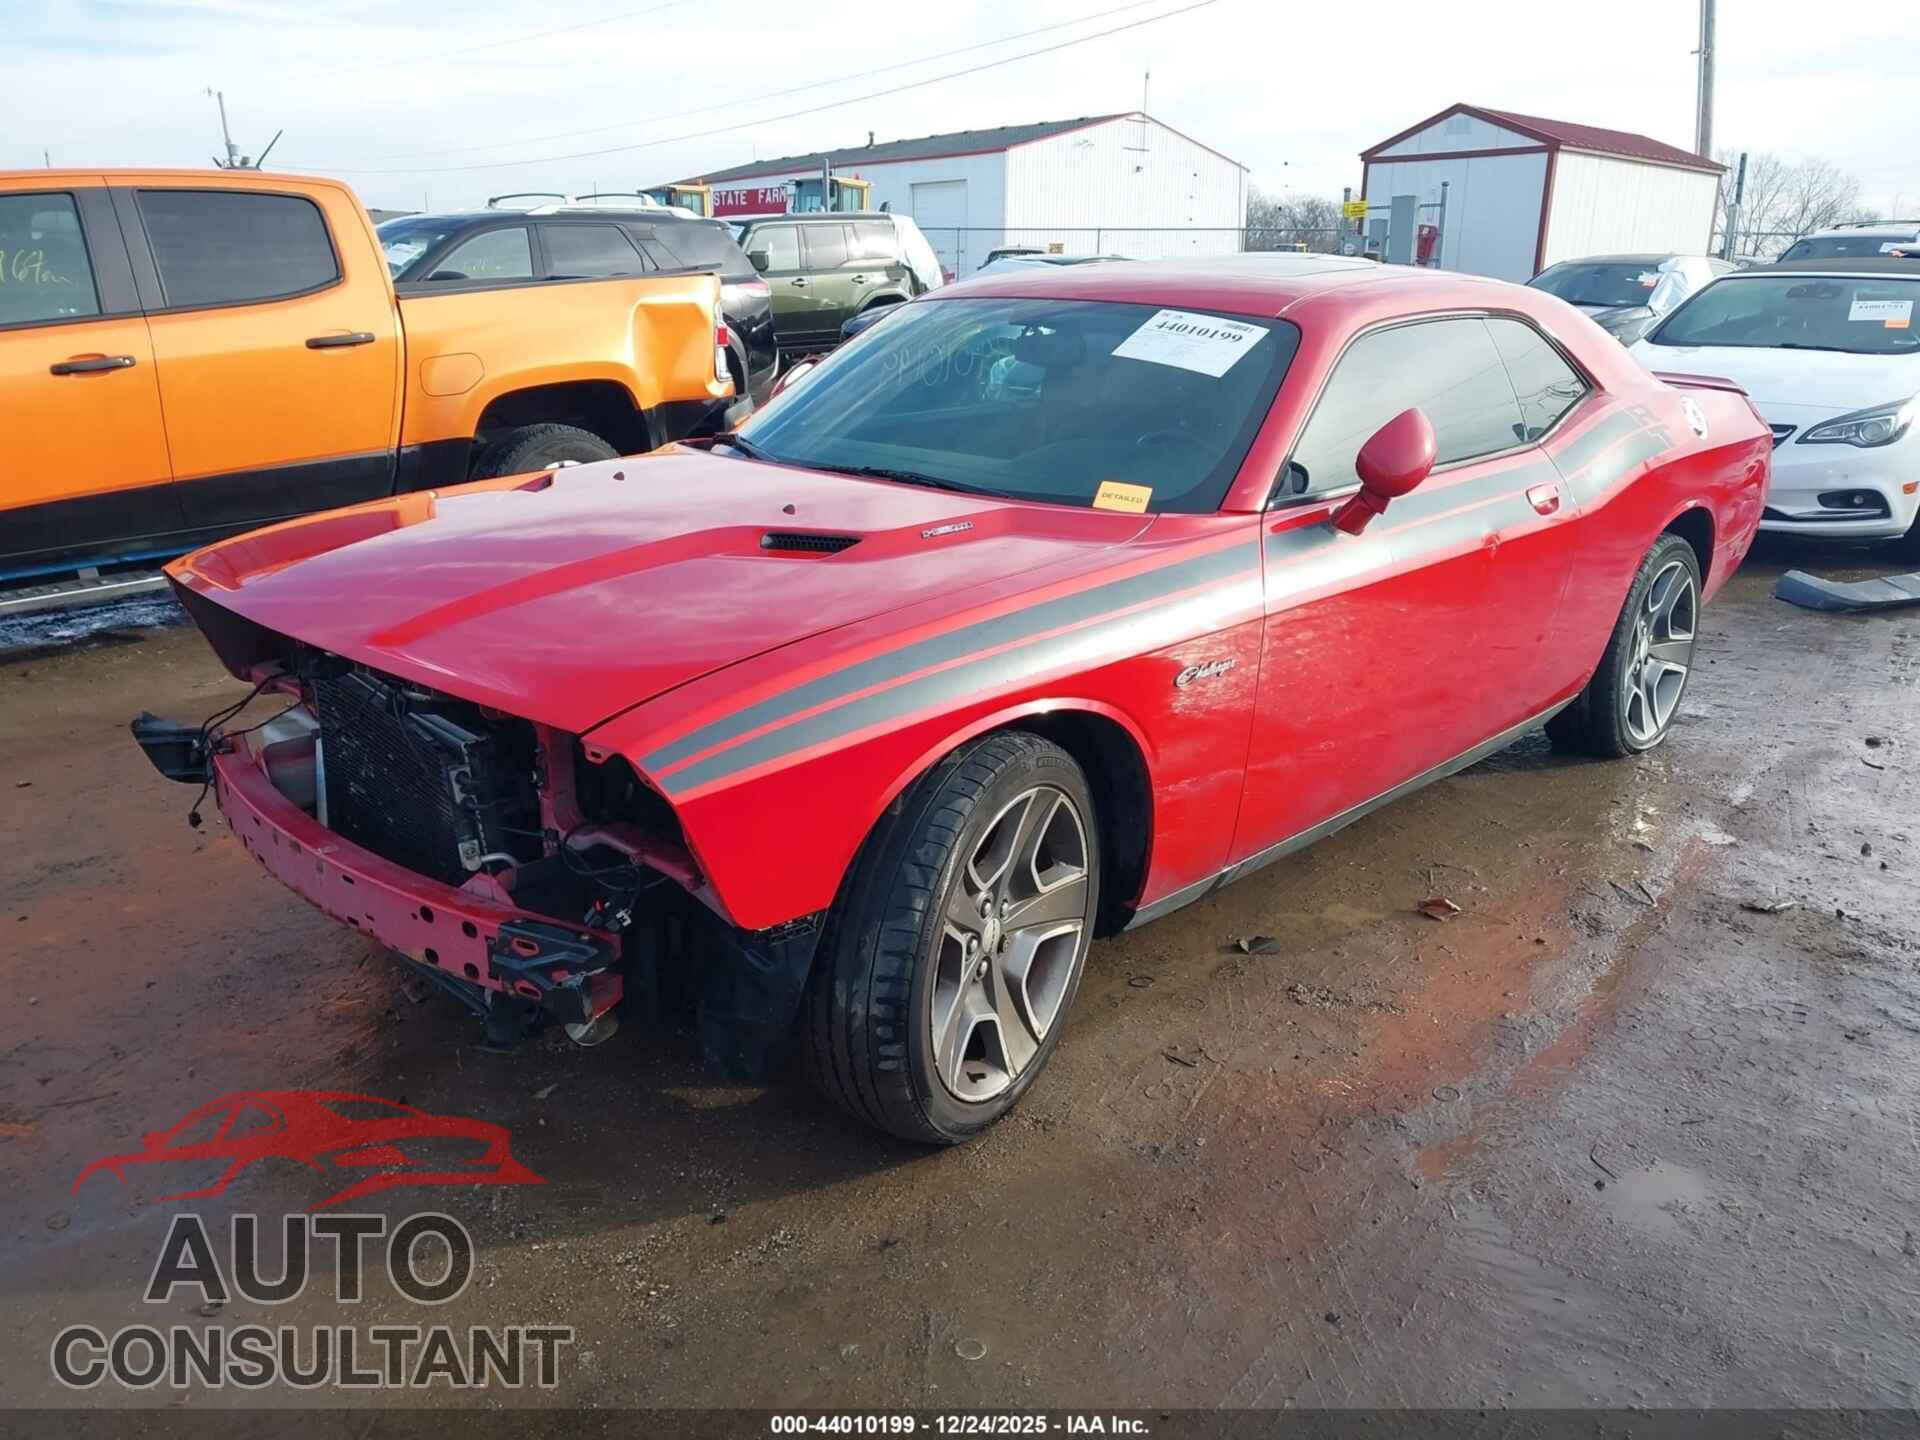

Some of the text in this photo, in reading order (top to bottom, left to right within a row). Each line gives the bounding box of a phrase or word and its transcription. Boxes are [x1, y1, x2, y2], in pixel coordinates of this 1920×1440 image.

[713, 187, 786, 207] STATE FARM
[1155, 320, 1243, 343] 44010199
